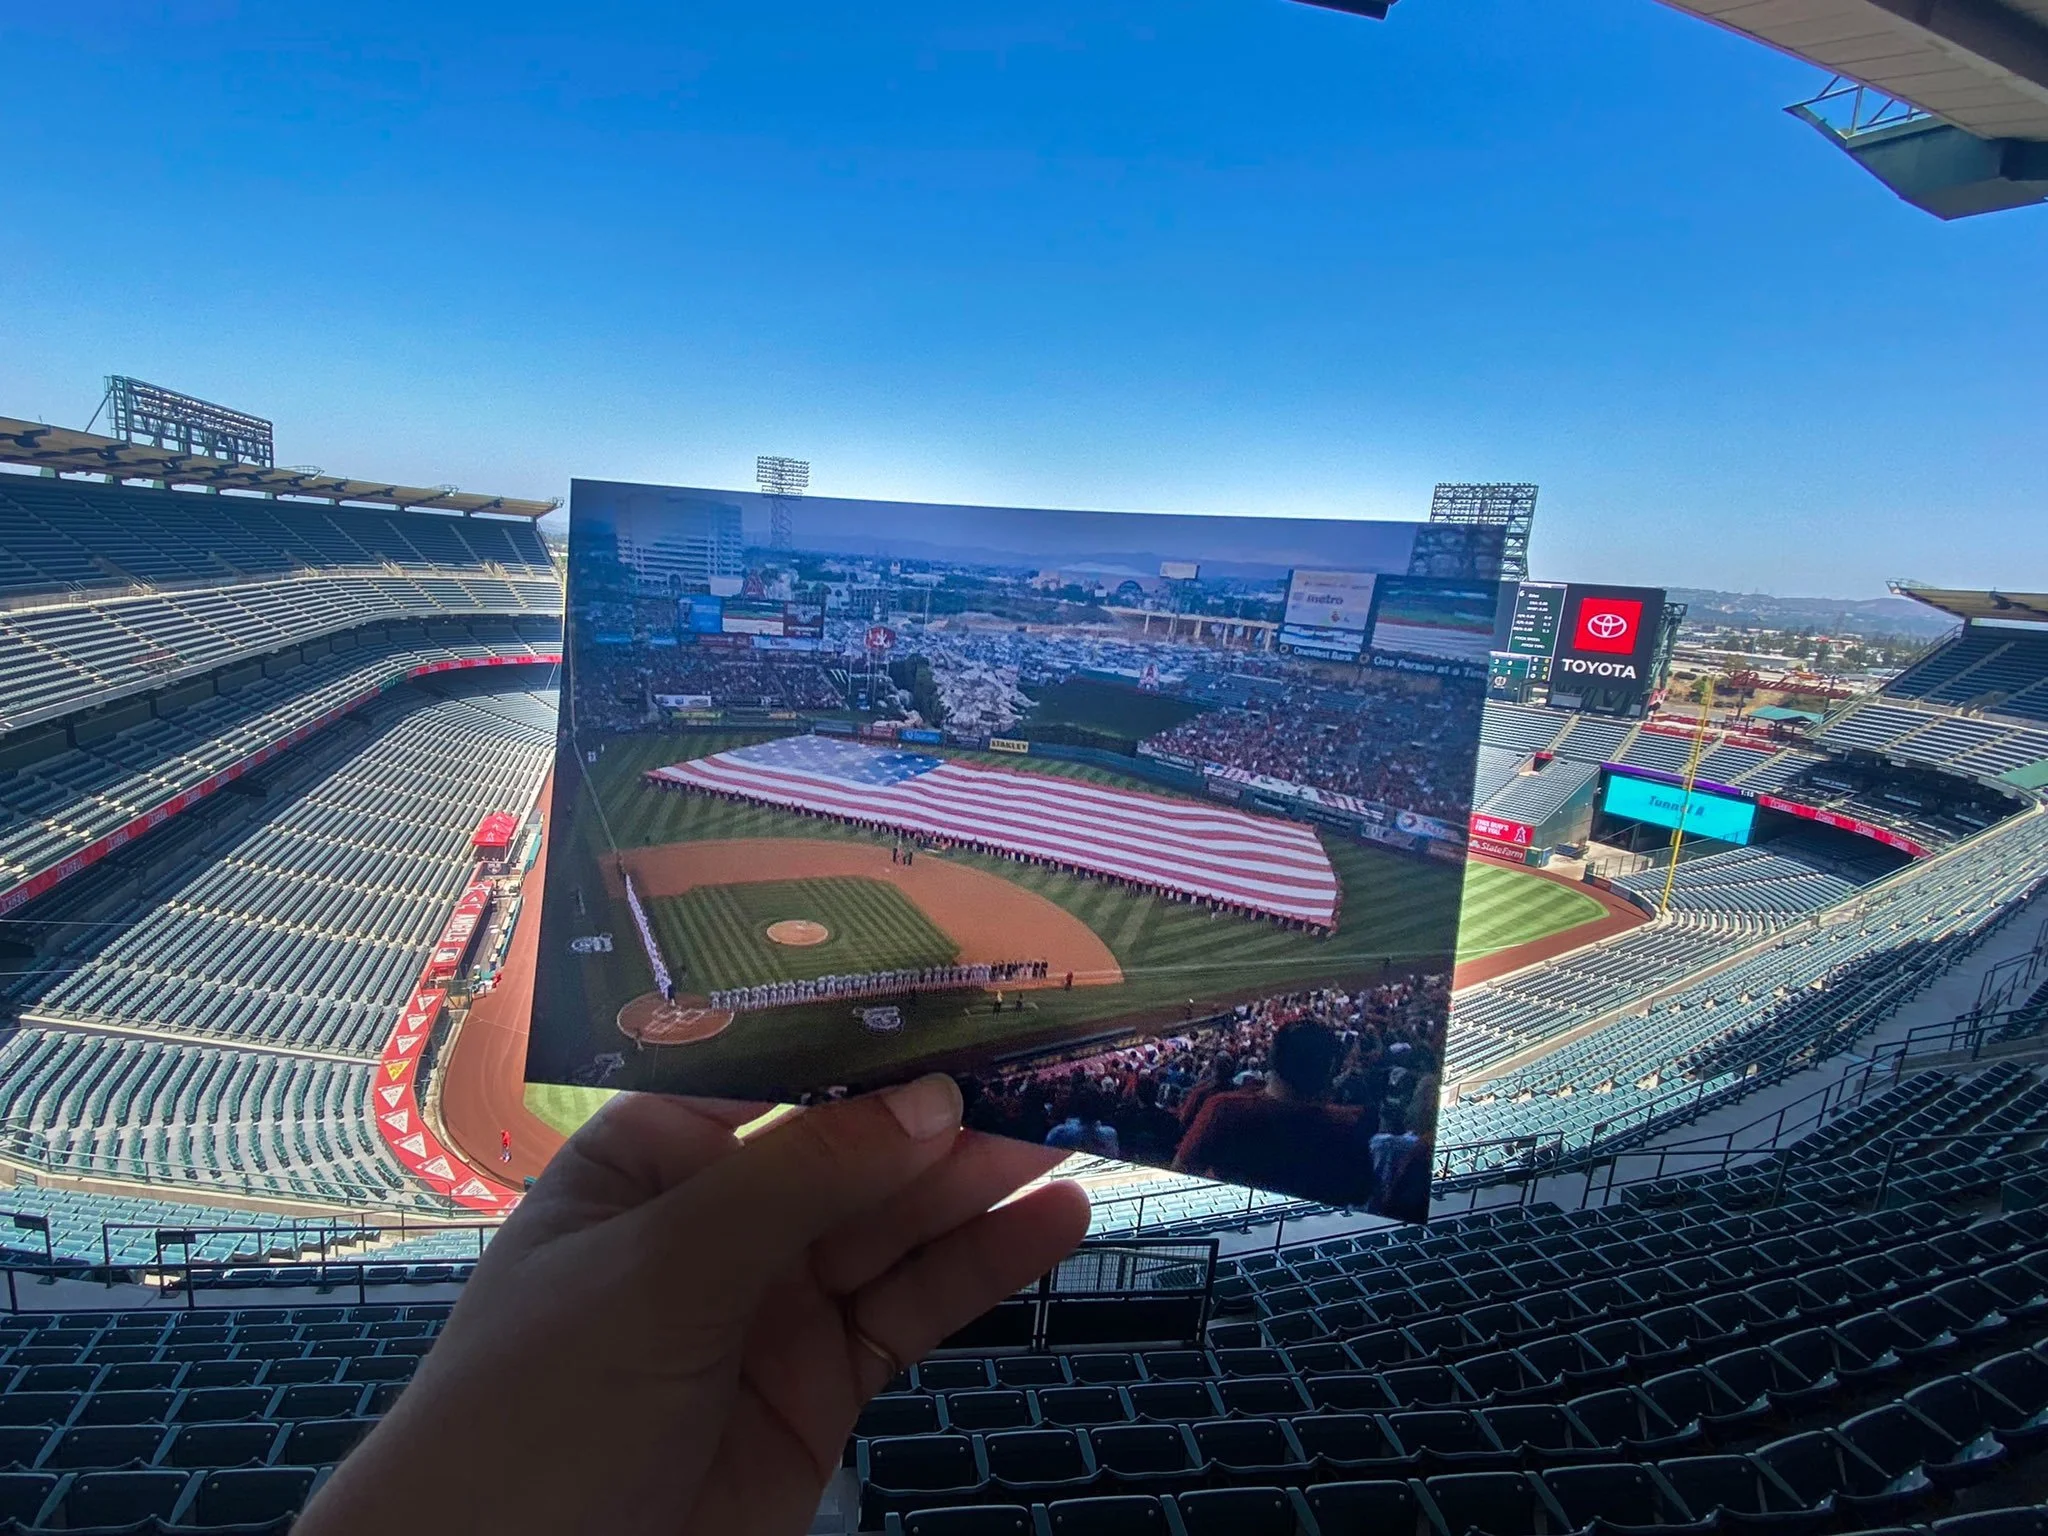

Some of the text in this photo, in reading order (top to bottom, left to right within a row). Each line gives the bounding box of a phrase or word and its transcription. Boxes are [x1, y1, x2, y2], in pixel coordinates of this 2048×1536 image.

[1306, 594, 1344, 605] metro
[1561, 658, 1637, 680] TOYOTA
[1695, 805, 1705, 816] A
